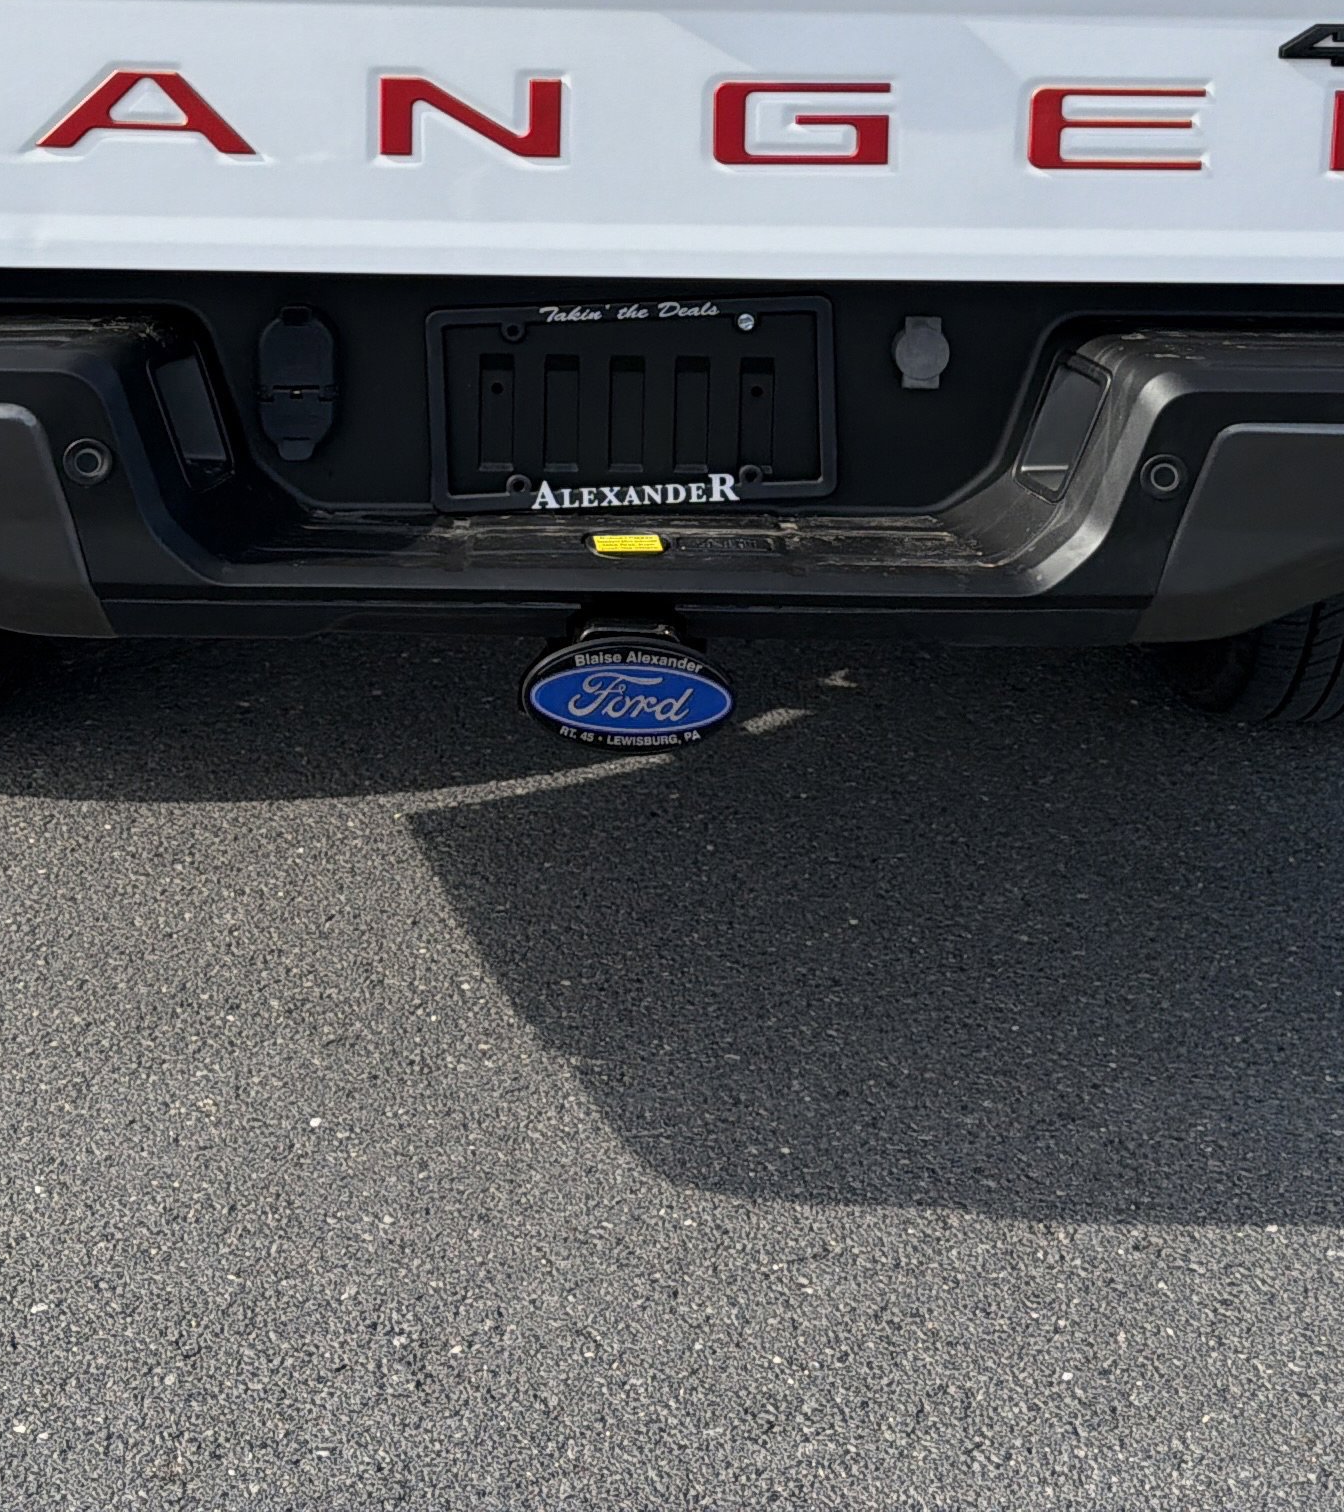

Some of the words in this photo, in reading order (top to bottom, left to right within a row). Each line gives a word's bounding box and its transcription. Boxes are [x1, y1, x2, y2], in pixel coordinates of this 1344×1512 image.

[539, 303, 610, 322] Takin'
[616, 303, 649, 319] the
[657, 301, 720, 318] Deals
[531, 473, 740, 509] ALEXANDER
[574, 652, 622, 667] Blaise
[625, 651, 704, 674] Alexander
[567, 672, 694, 721] Ford
[580, 732, 595, 743] 45
[606, 734, 682, 747] LEWISBURG,
[684, 729, 702, 742] PA
